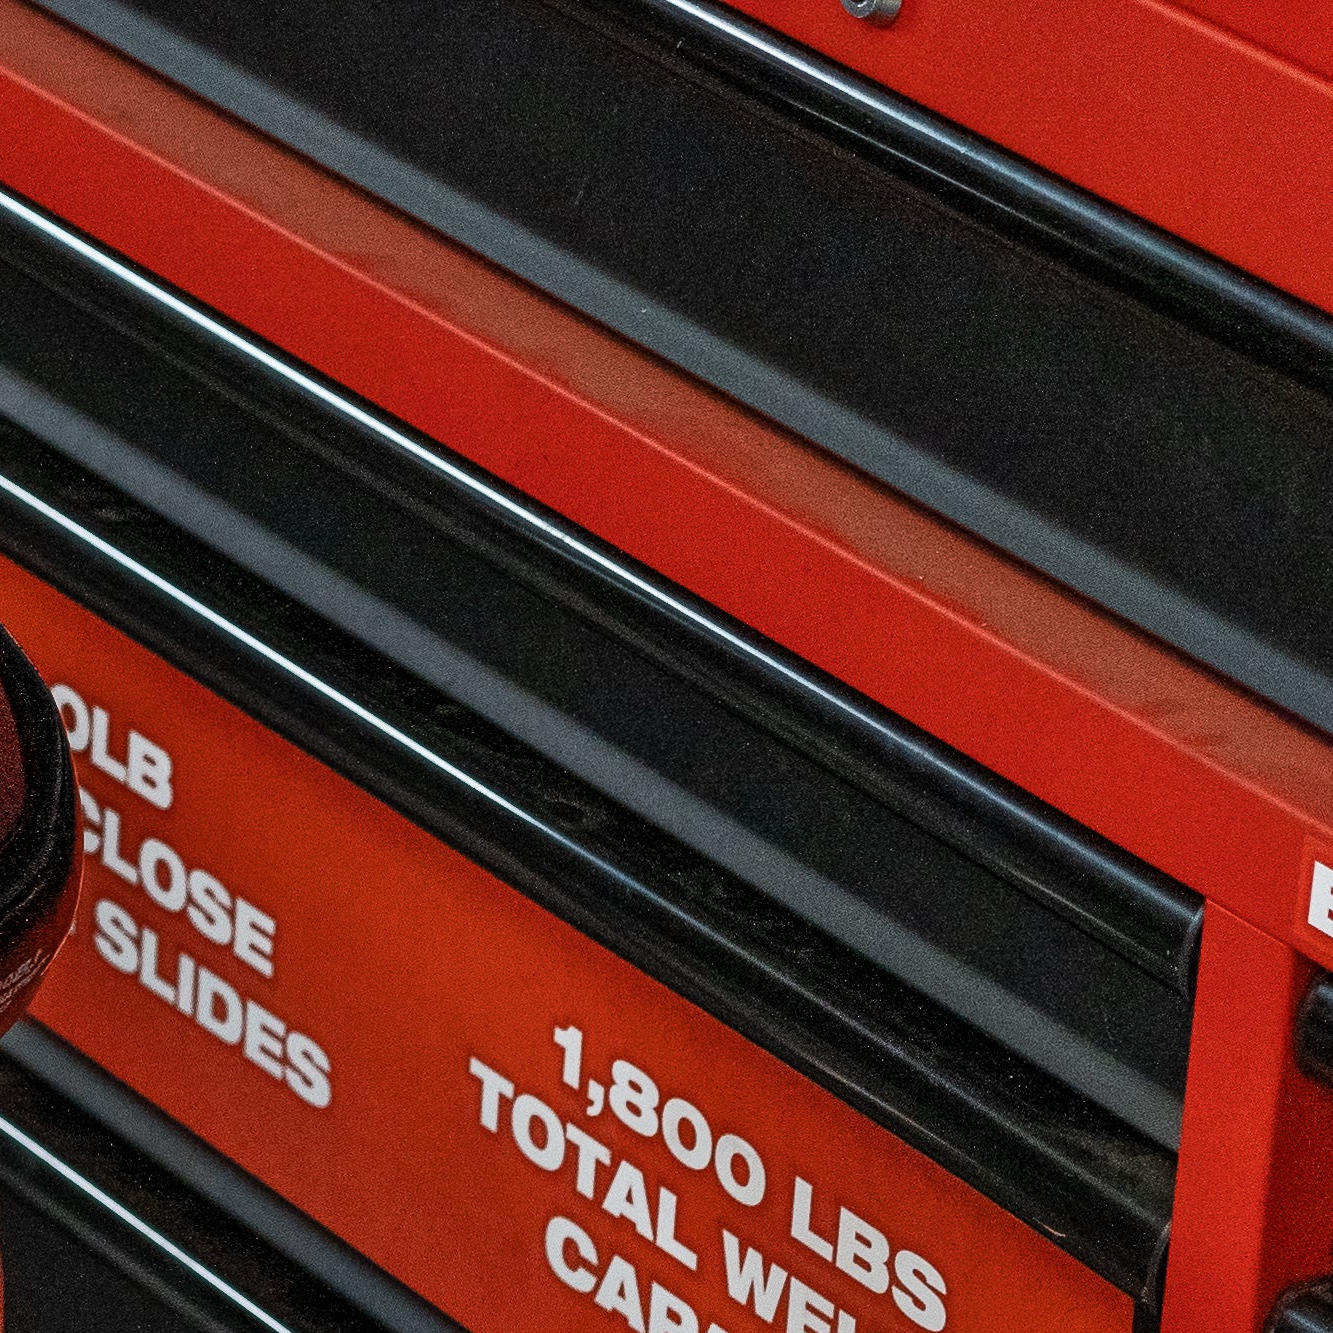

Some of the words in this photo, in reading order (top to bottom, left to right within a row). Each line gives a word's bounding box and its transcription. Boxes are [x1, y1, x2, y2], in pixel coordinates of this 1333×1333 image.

[94, 899, 332, 1108] SLIDES
[469, 1057, 698, 1271] TOTAL
[554, 1026, 766, 1207] 1,800
[791, 1176, 948, 1332] LBS
